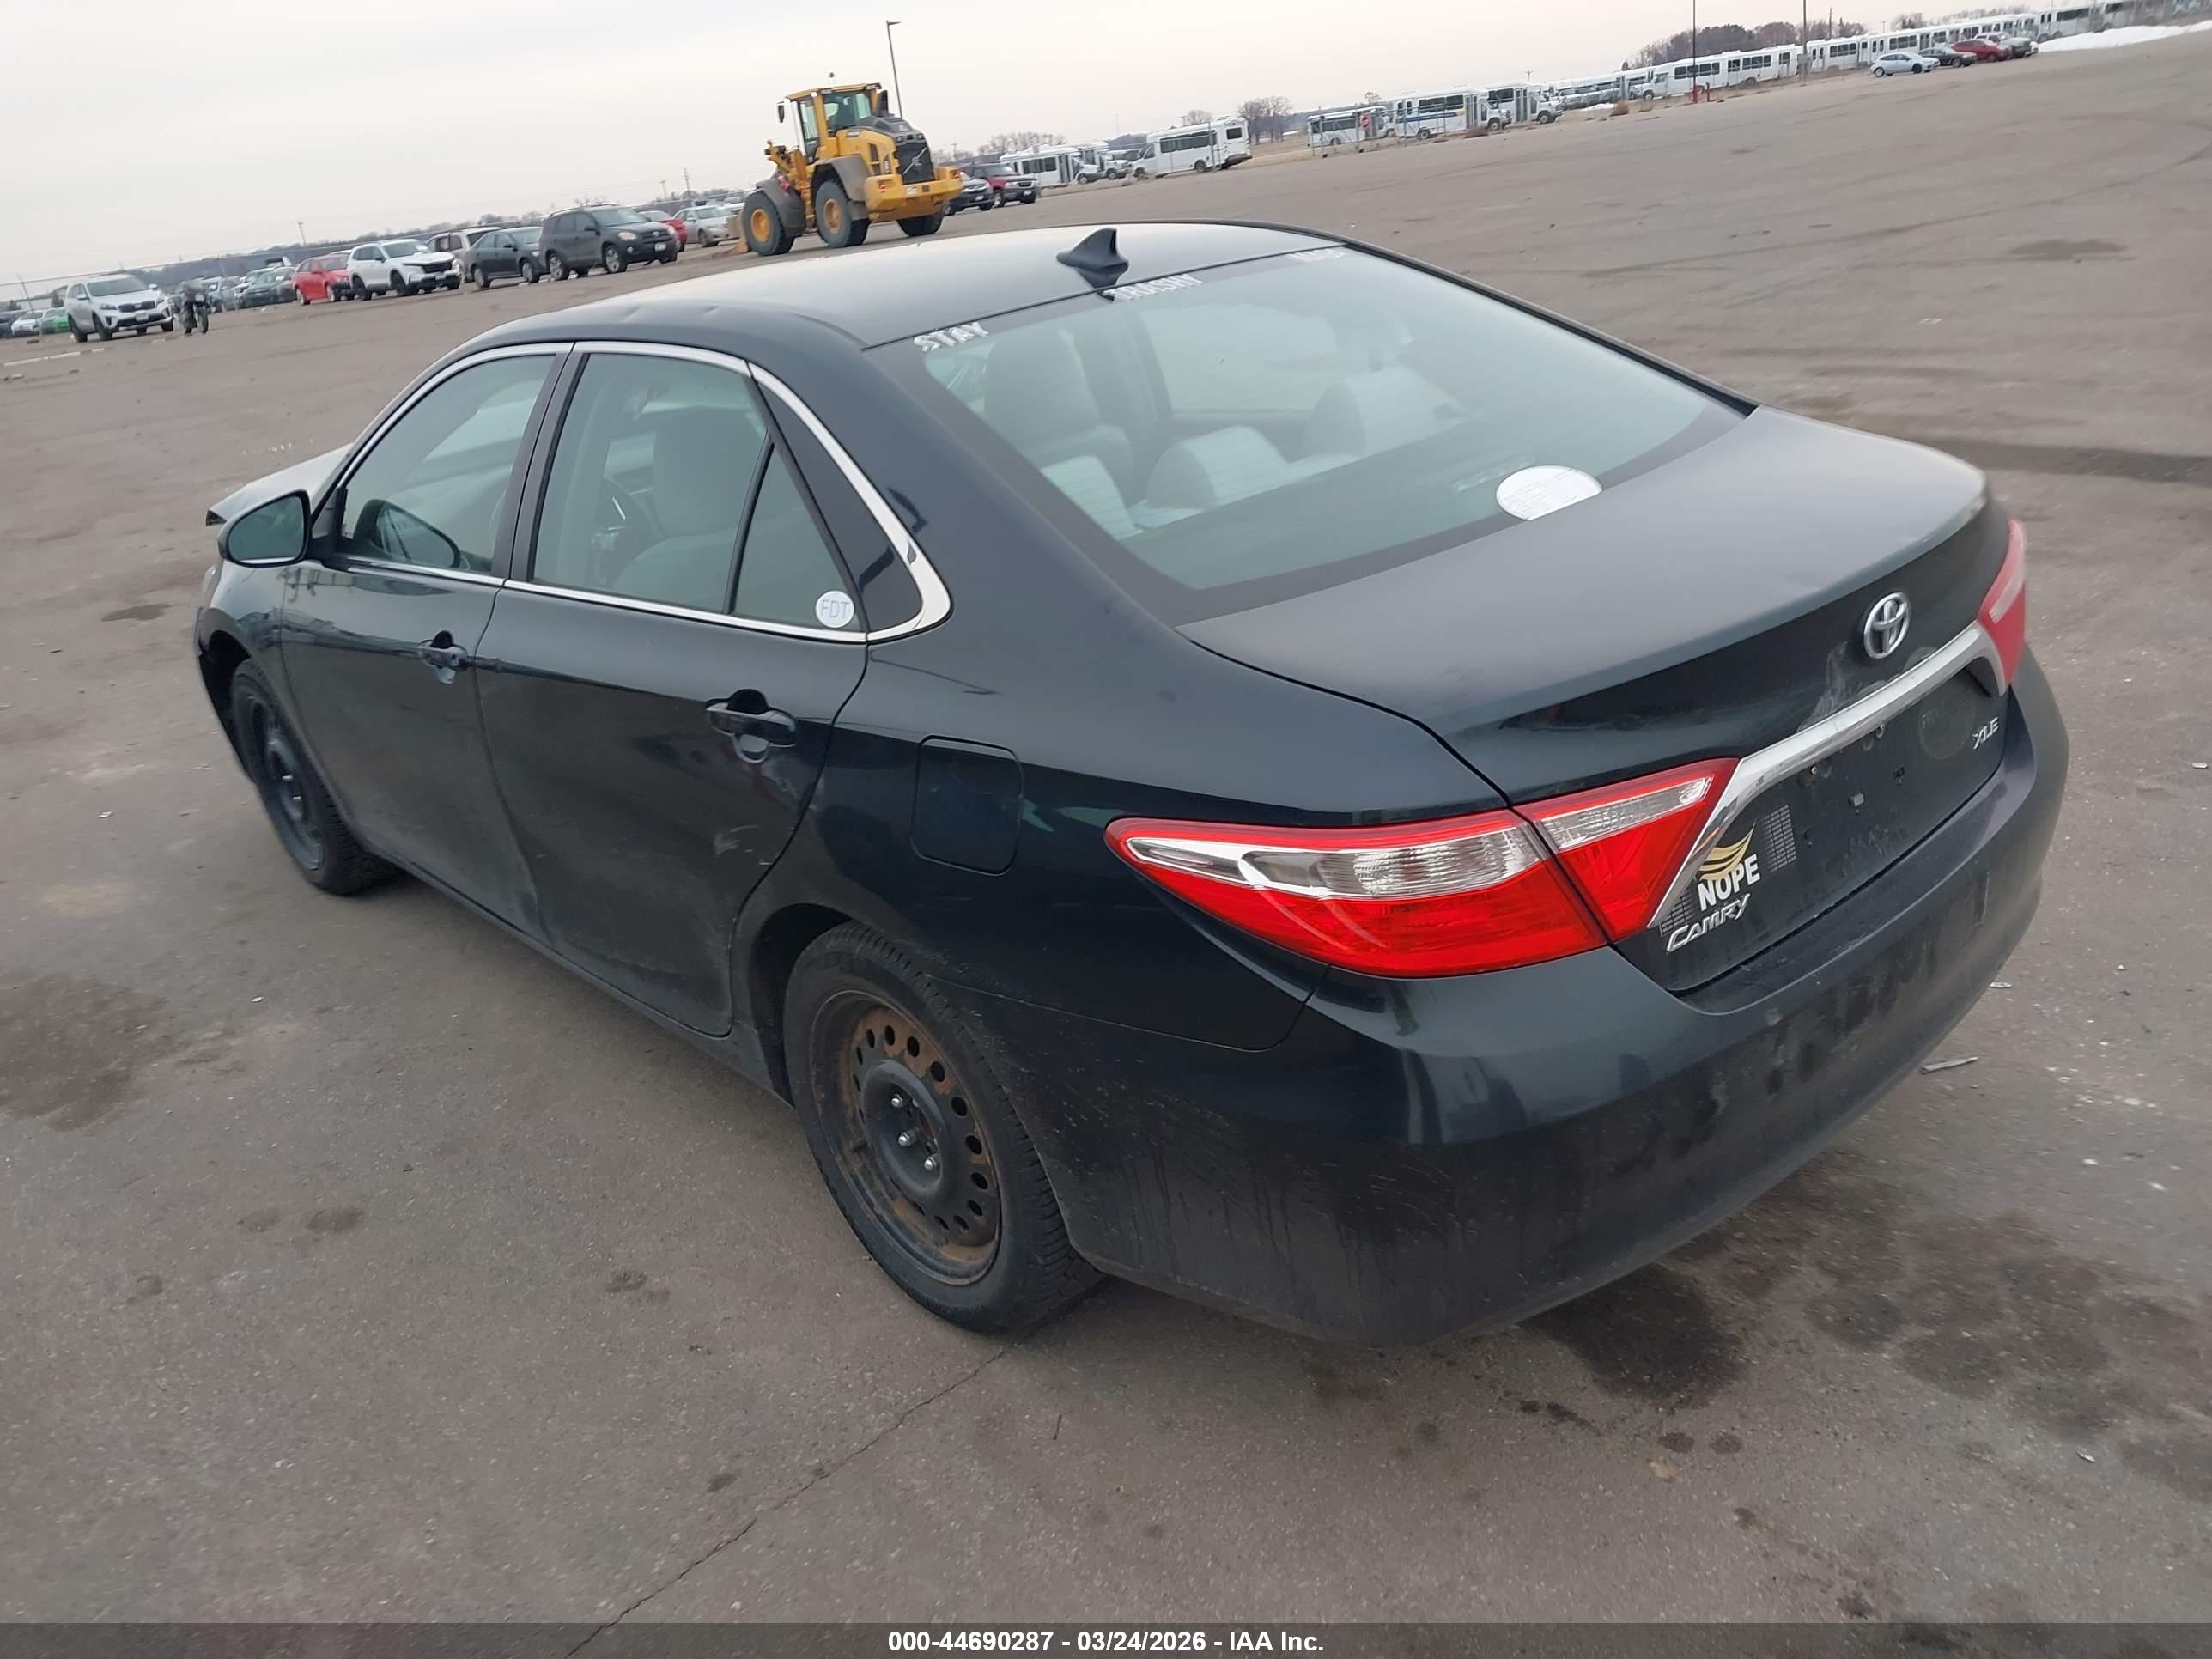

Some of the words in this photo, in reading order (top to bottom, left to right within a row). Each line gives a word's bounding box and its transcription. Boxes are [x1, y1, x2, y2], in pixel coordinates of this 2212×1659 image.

[913, 321, 990, 352] STAY
[1102, 273, 1203, 301] TRASHY
[820, 599, 850, 619] FDT
[1972, 716, 1999, 750] XLE
[1697, 853, 1761, 912] NOPE
[1666, 893, 1751, 952] CAMRY
